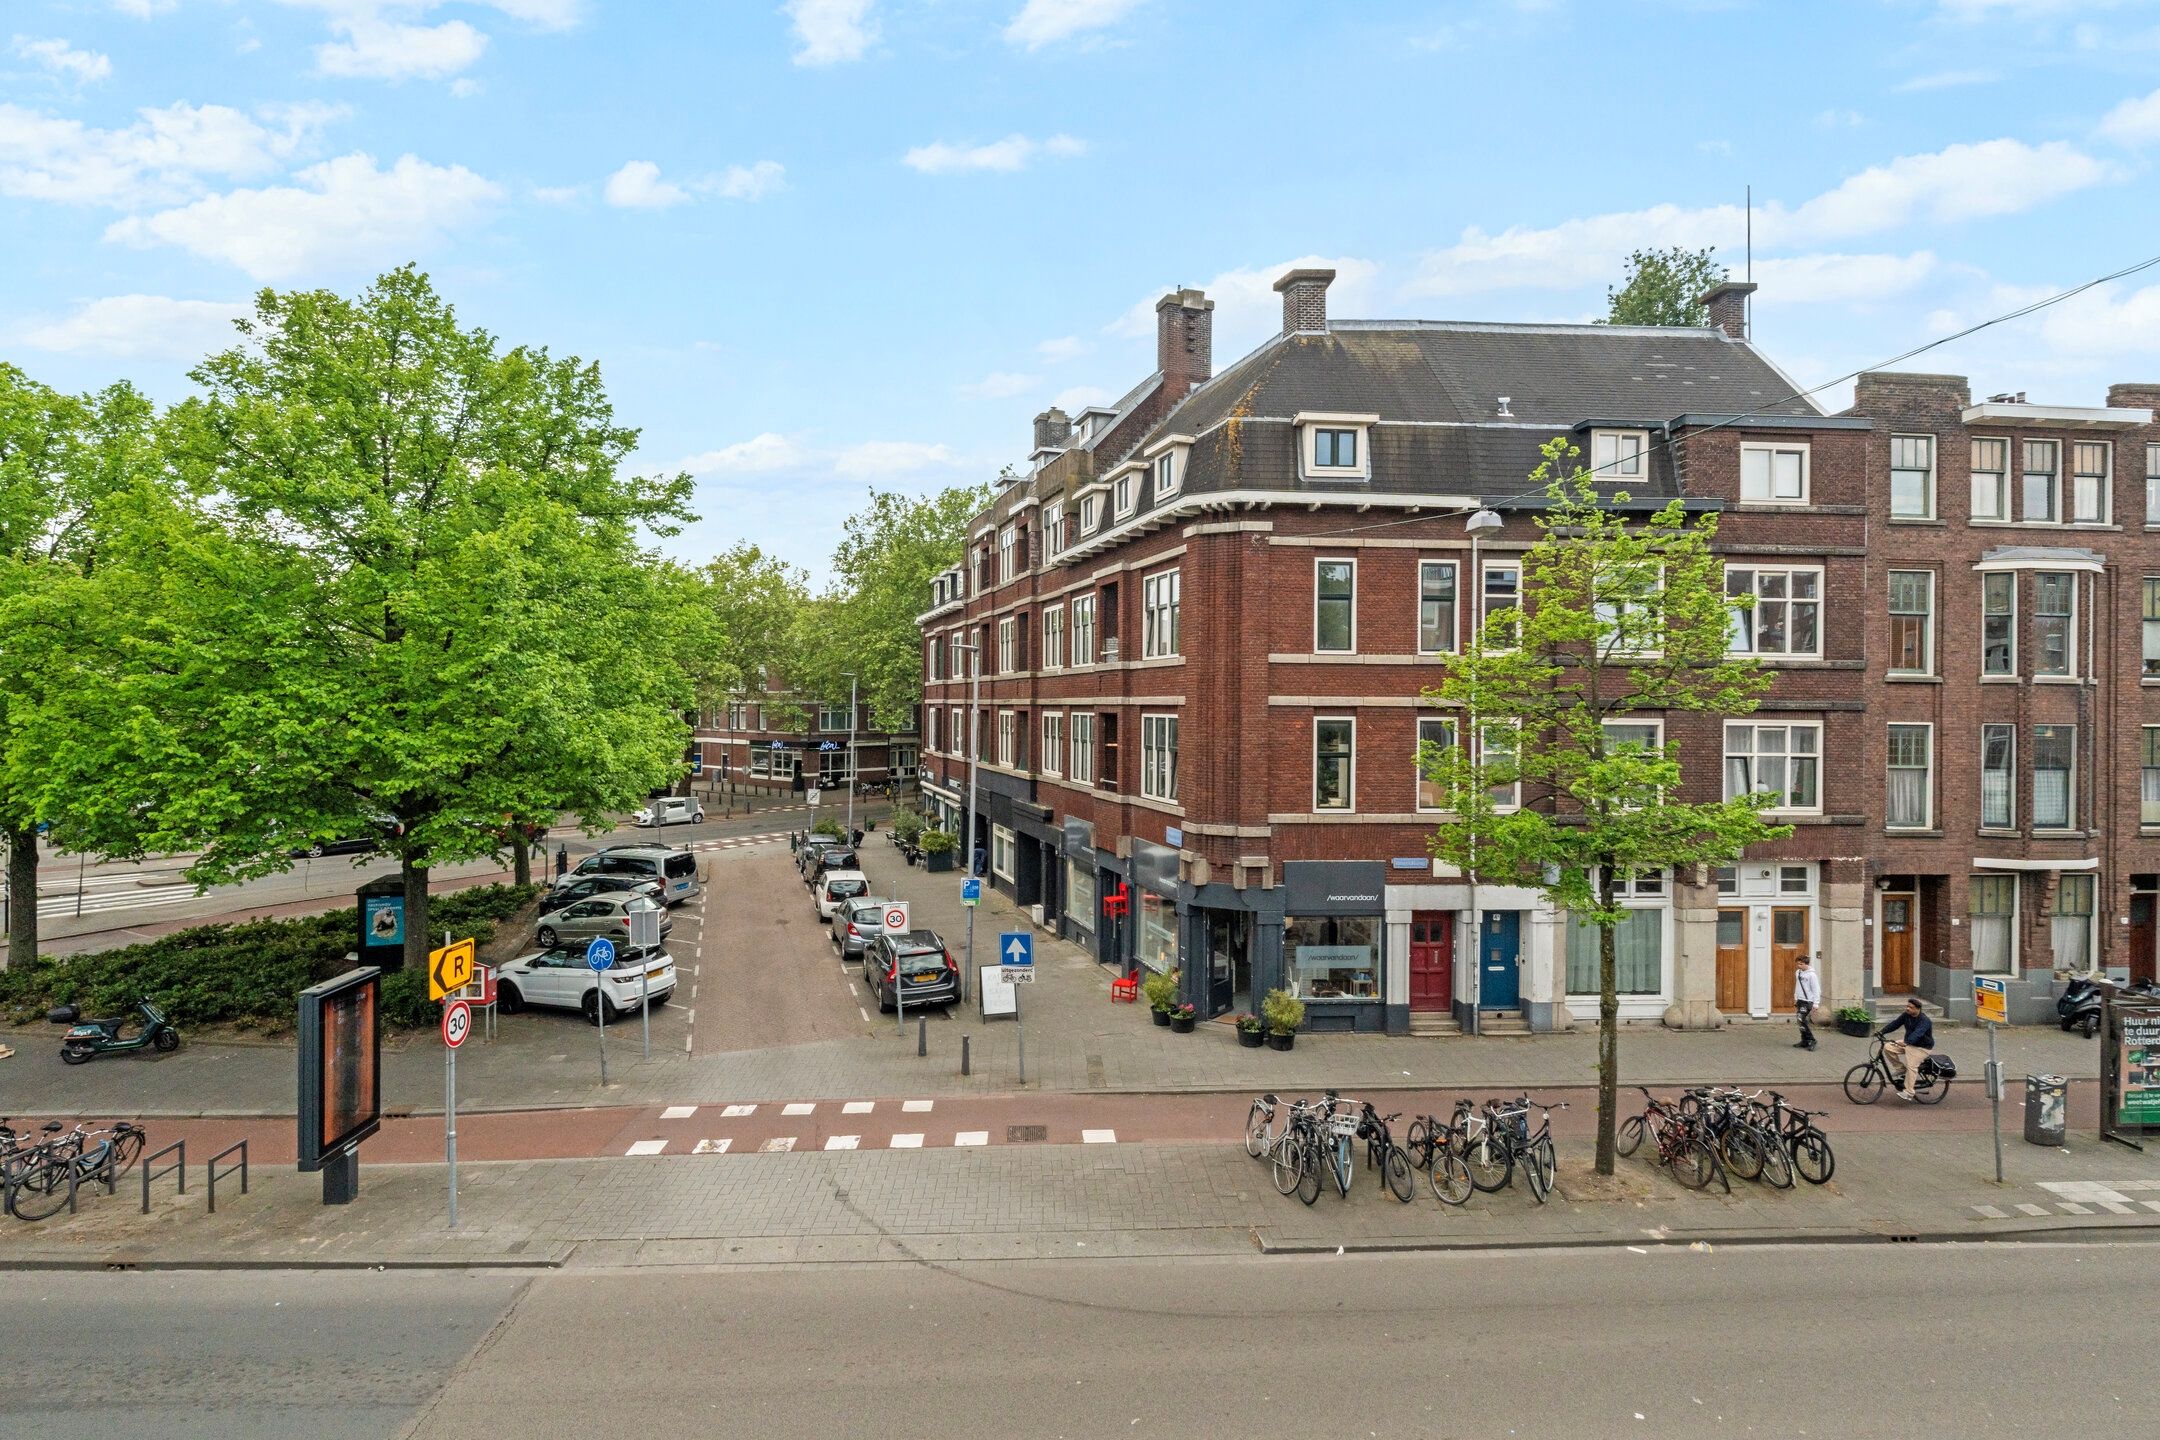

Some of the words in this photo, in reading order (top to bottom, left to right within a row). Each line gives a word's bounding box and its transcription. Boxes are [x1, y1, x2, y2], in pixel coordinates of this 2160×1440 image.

[889, 915, 902, 923] 30
[454, 955, 464, 978] R
[449, 1013, 466, 1035] 30
[2123, 1016, 2149, 1026] Huur
[2124, 1027, 2135, 1036] te
[2136, 1026, 2160, 1036] duur
